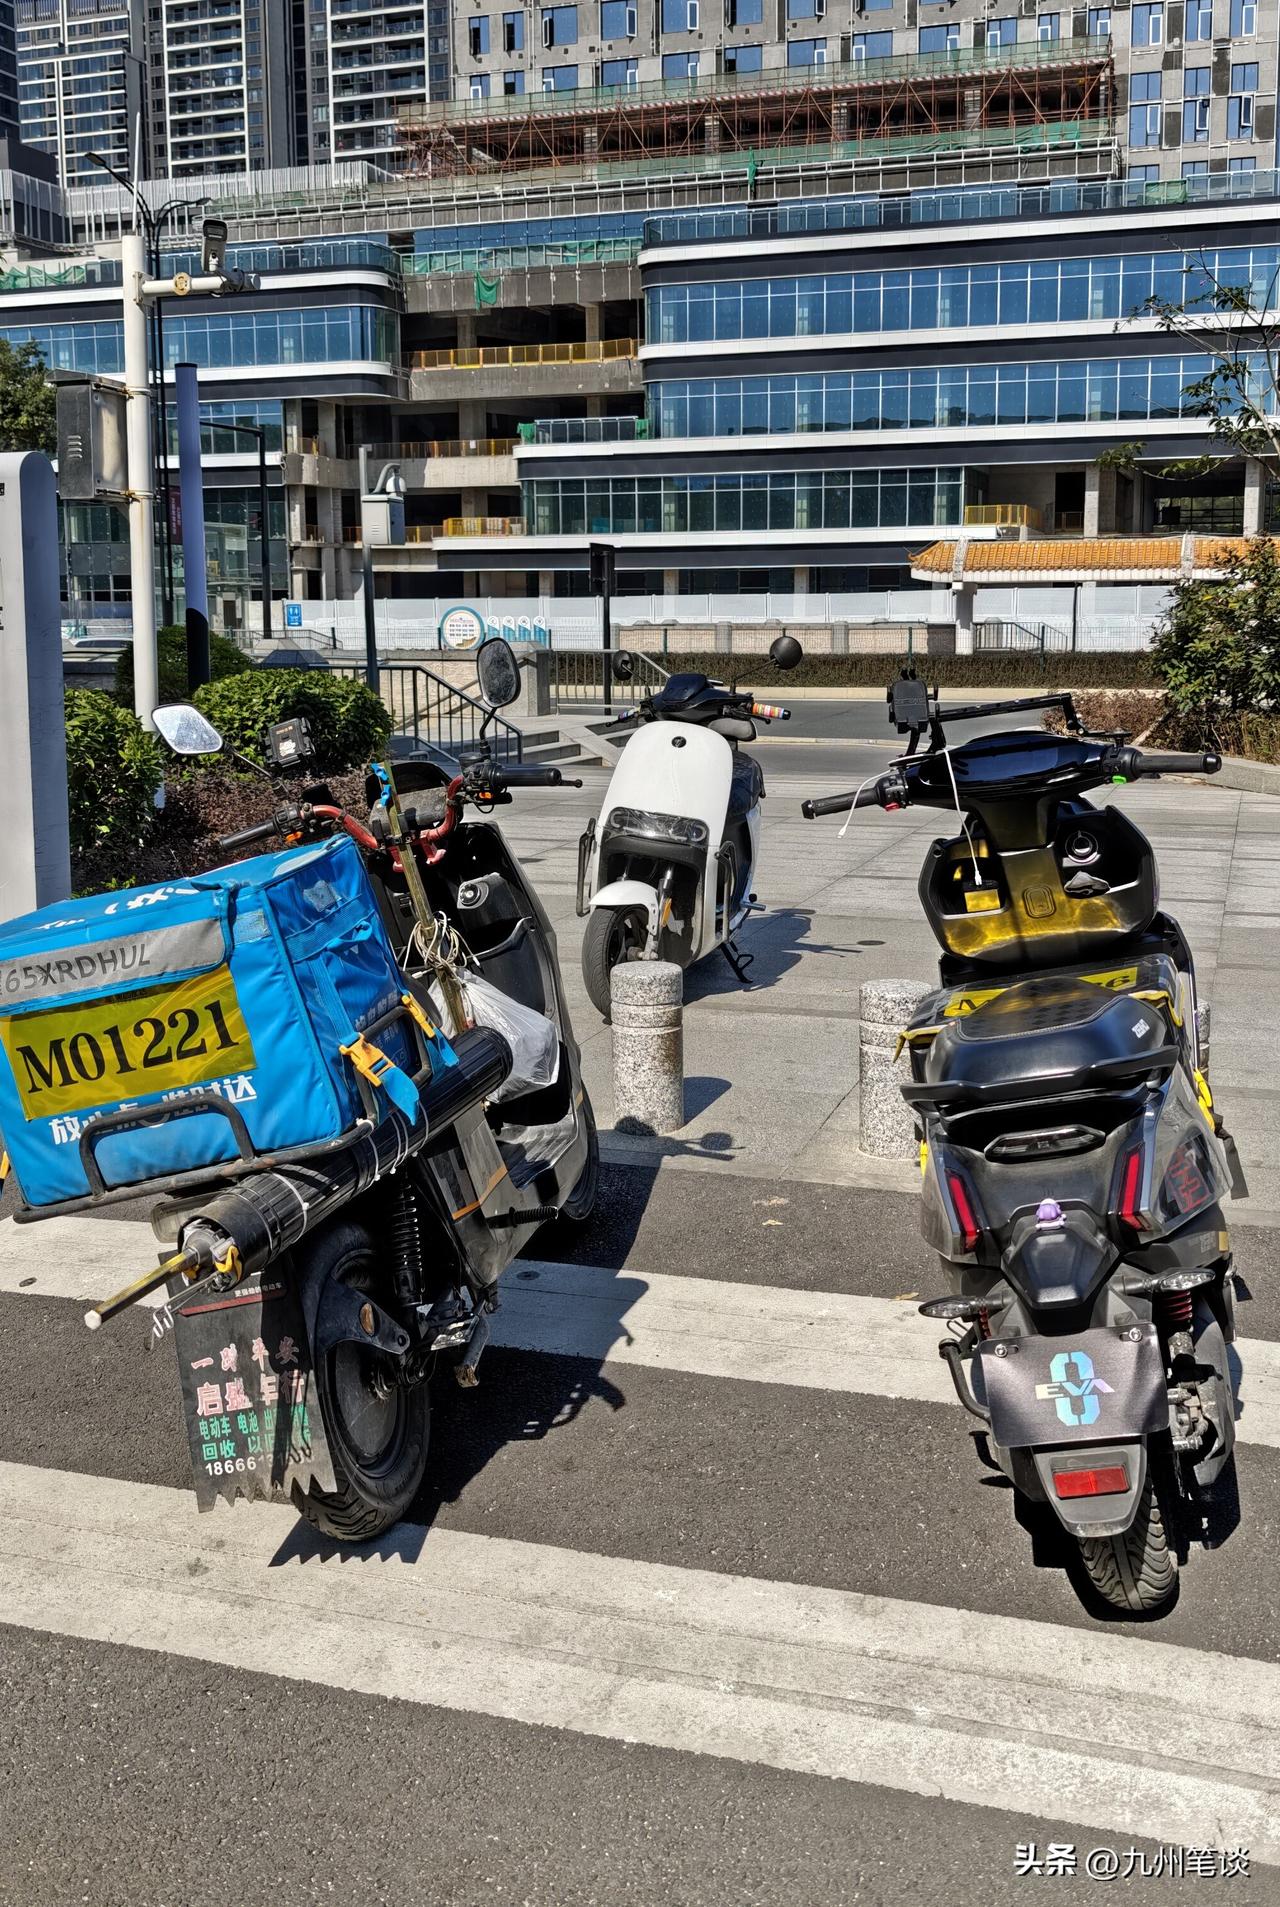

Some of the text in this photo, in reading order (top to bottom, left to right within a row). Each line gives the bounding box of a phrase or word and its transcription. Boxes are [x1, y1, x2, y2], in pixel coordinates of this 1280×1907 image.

[16, 1000, 239, 1093] M01221
[199, 1415, 232, 1440] 电动车
[237, 1409, 259, 1434] 电池
[202, 1439, 236, 1461] 回收
